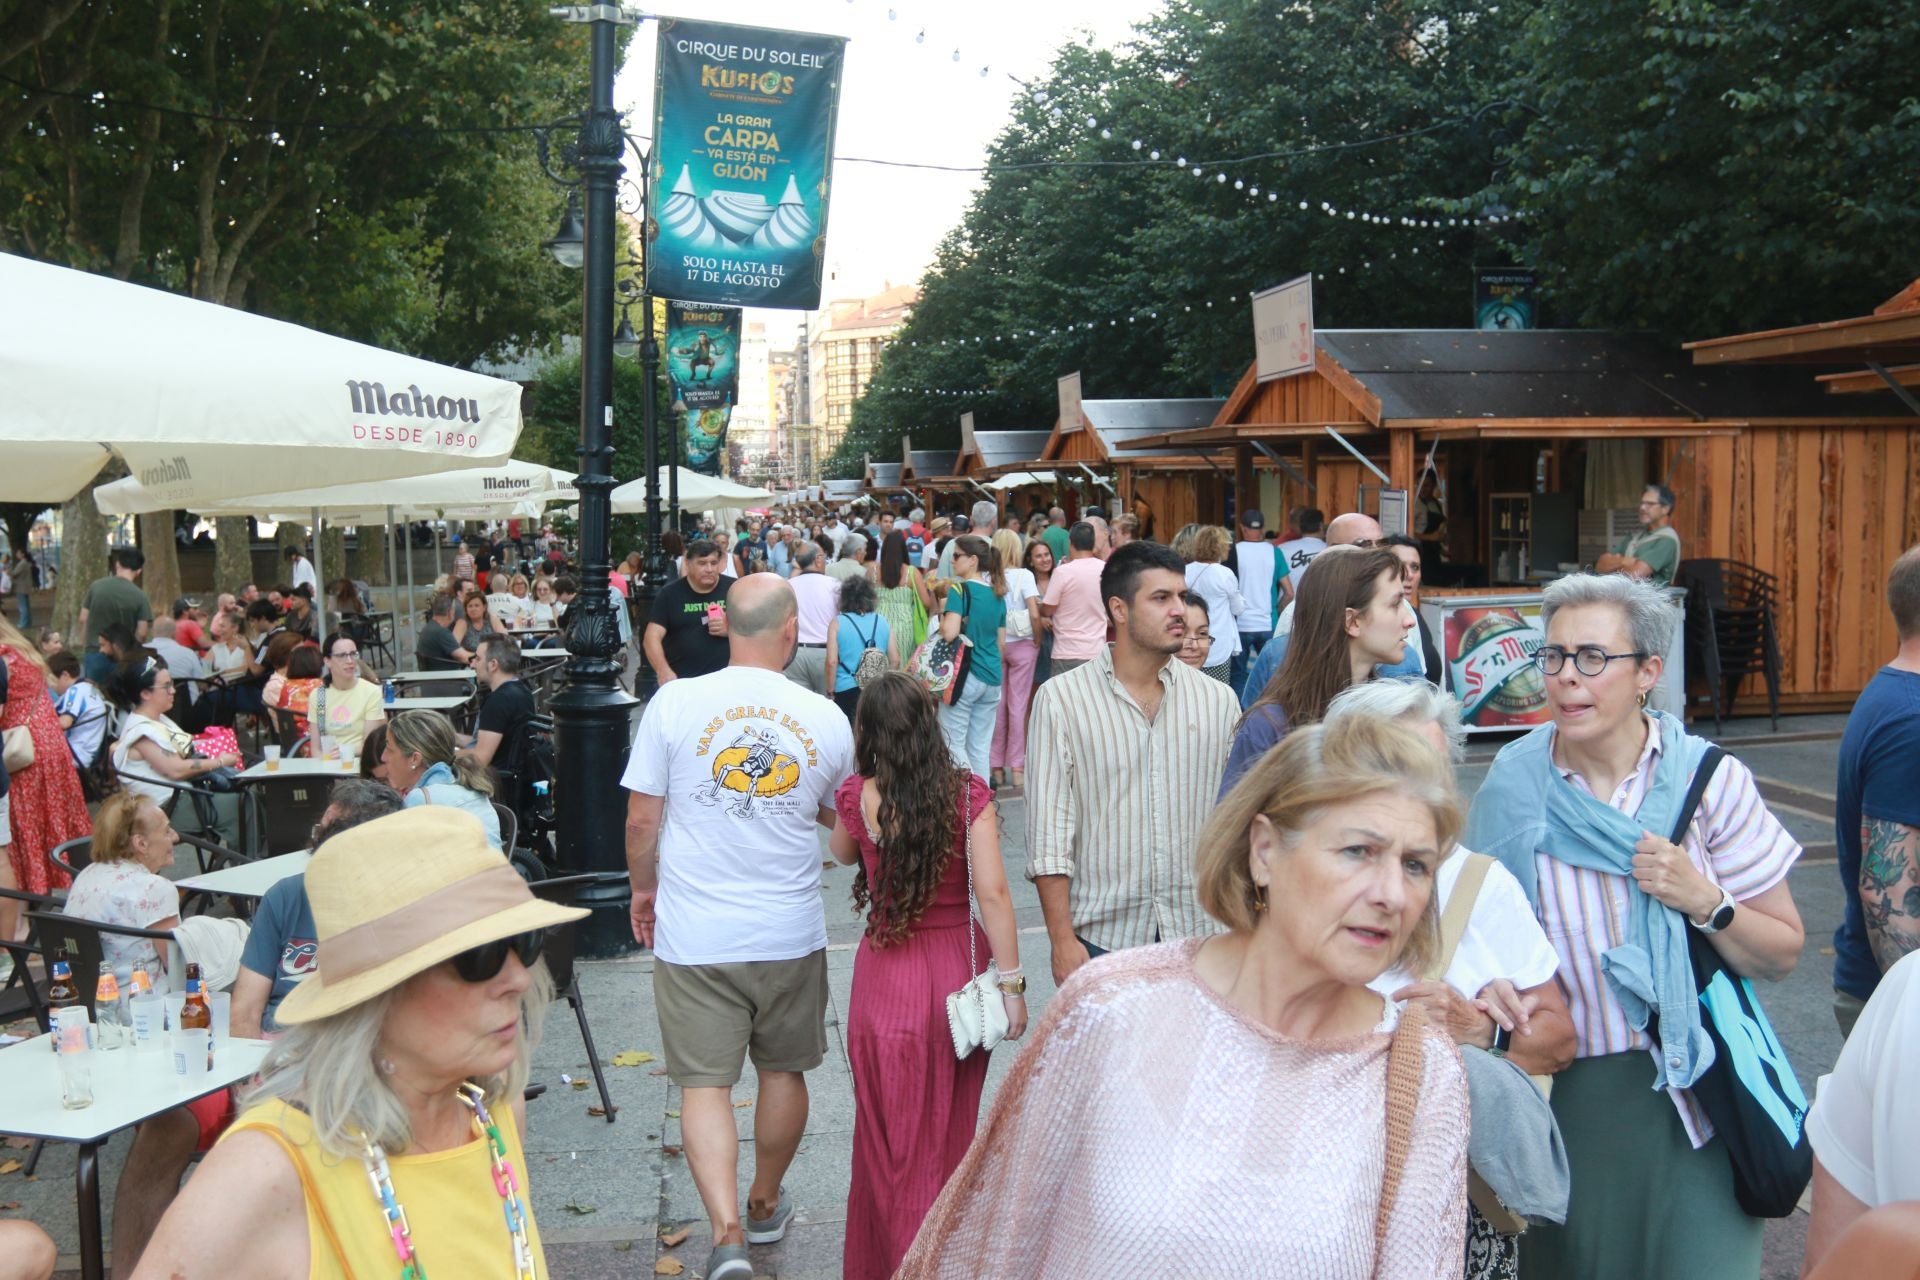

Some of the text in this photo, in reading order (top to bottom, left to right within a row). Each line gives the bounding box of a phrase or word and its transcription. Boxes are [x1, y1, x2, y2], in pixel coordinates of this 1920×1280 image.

[677, 40, 823, 69] CIRQUE DU SOLEIL
[717, 113, 772, 128] LA GRAN
[704, 125, 780, 152] CARPA
[707, 148, 776, 165] YA ESTÁ EN
[712, 161, 768, 182] GIJÓN
[682, 255, 785, 277] SOLO HASTA EL
[687, 269, 781, 289] 17 DE AGOSTO
[345, 379, 480, 423] Mahou
[353, 425, 477, 449] DESDE 1890
[483, 476, 530, 490] Mahou
[684, 603, 703, 613] JUST
[696, 706, 818, 768] VANS GREAT ESCAPE
